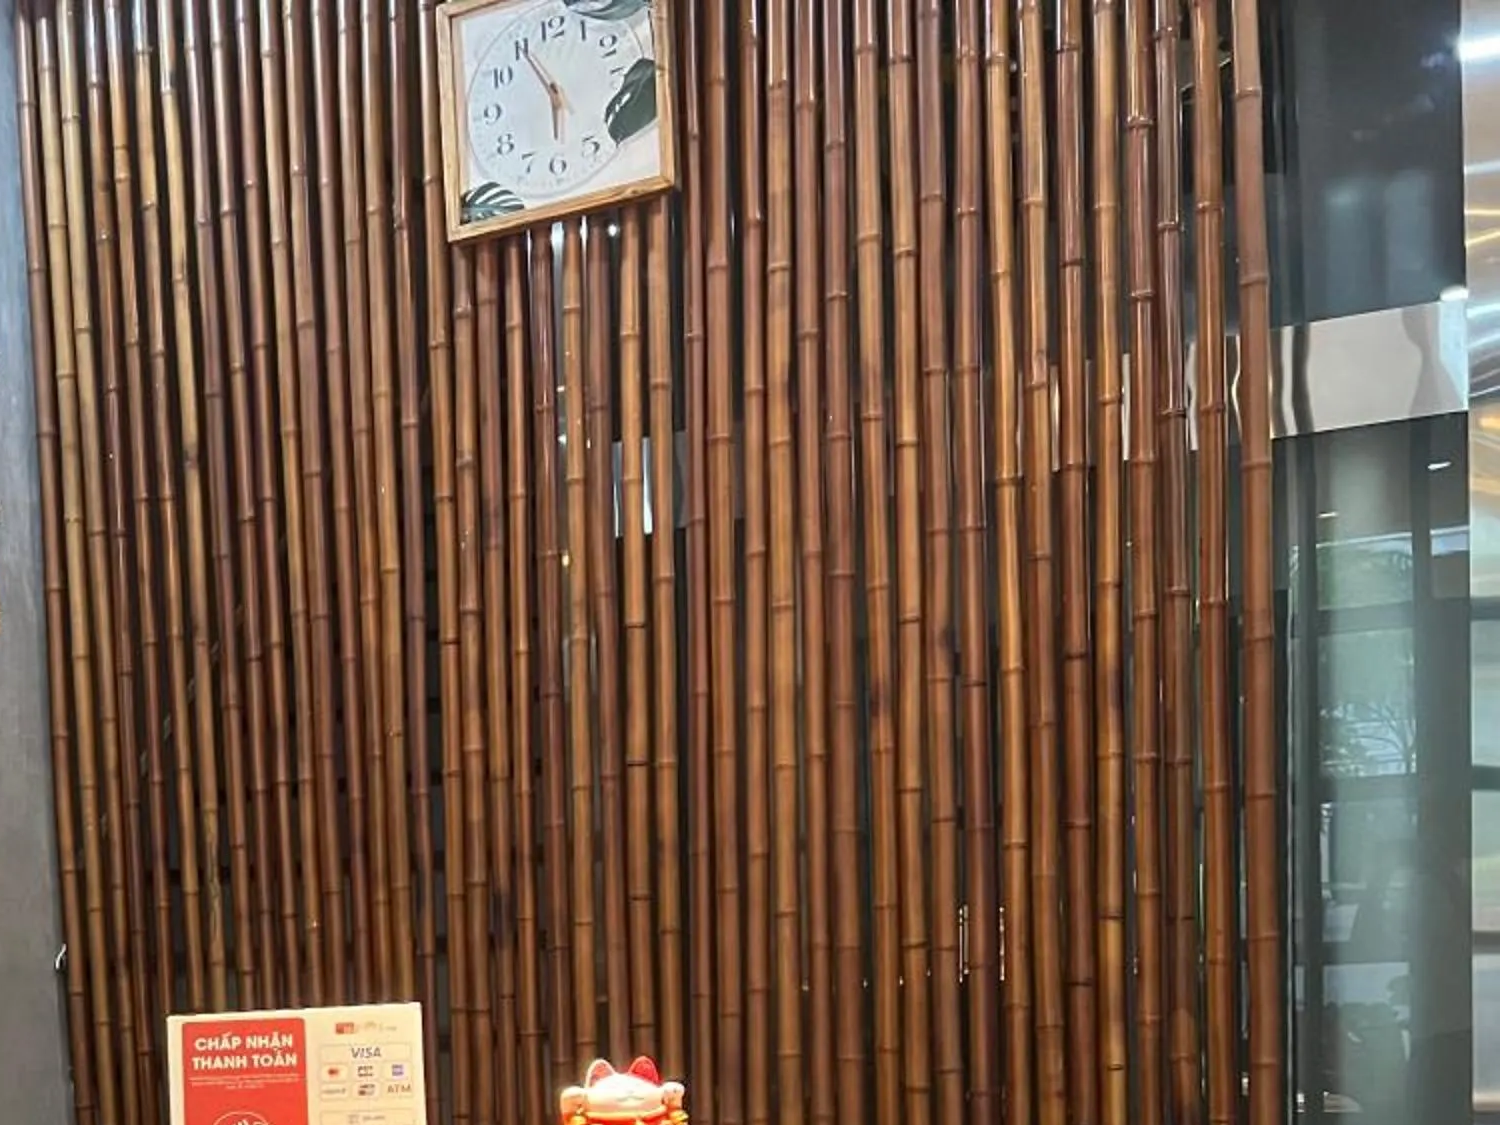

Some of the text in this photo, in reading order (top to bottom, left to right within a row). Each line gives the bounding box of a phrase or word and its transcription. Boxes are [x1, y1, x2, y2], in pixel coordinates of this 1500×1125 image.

[541, 16, 565, 42] 12
[580, 20, 587, 41] 1
[599, 34, 617, 58] 2
[493, 66, 513, 89] 10
[483, 103, 502, 125] 9
[497, 133, 515, 155] 8
[581, 135, 600, 162] 5
[521, 152, 534, 174] 7
[549, 156, 567, 175] 6
[194, 1031, 293, 1052] CHẤP NHẬN
[351, 1046, 382, 1059] VISA
[192, 1050, 298, 1070] THANH TOÁN
